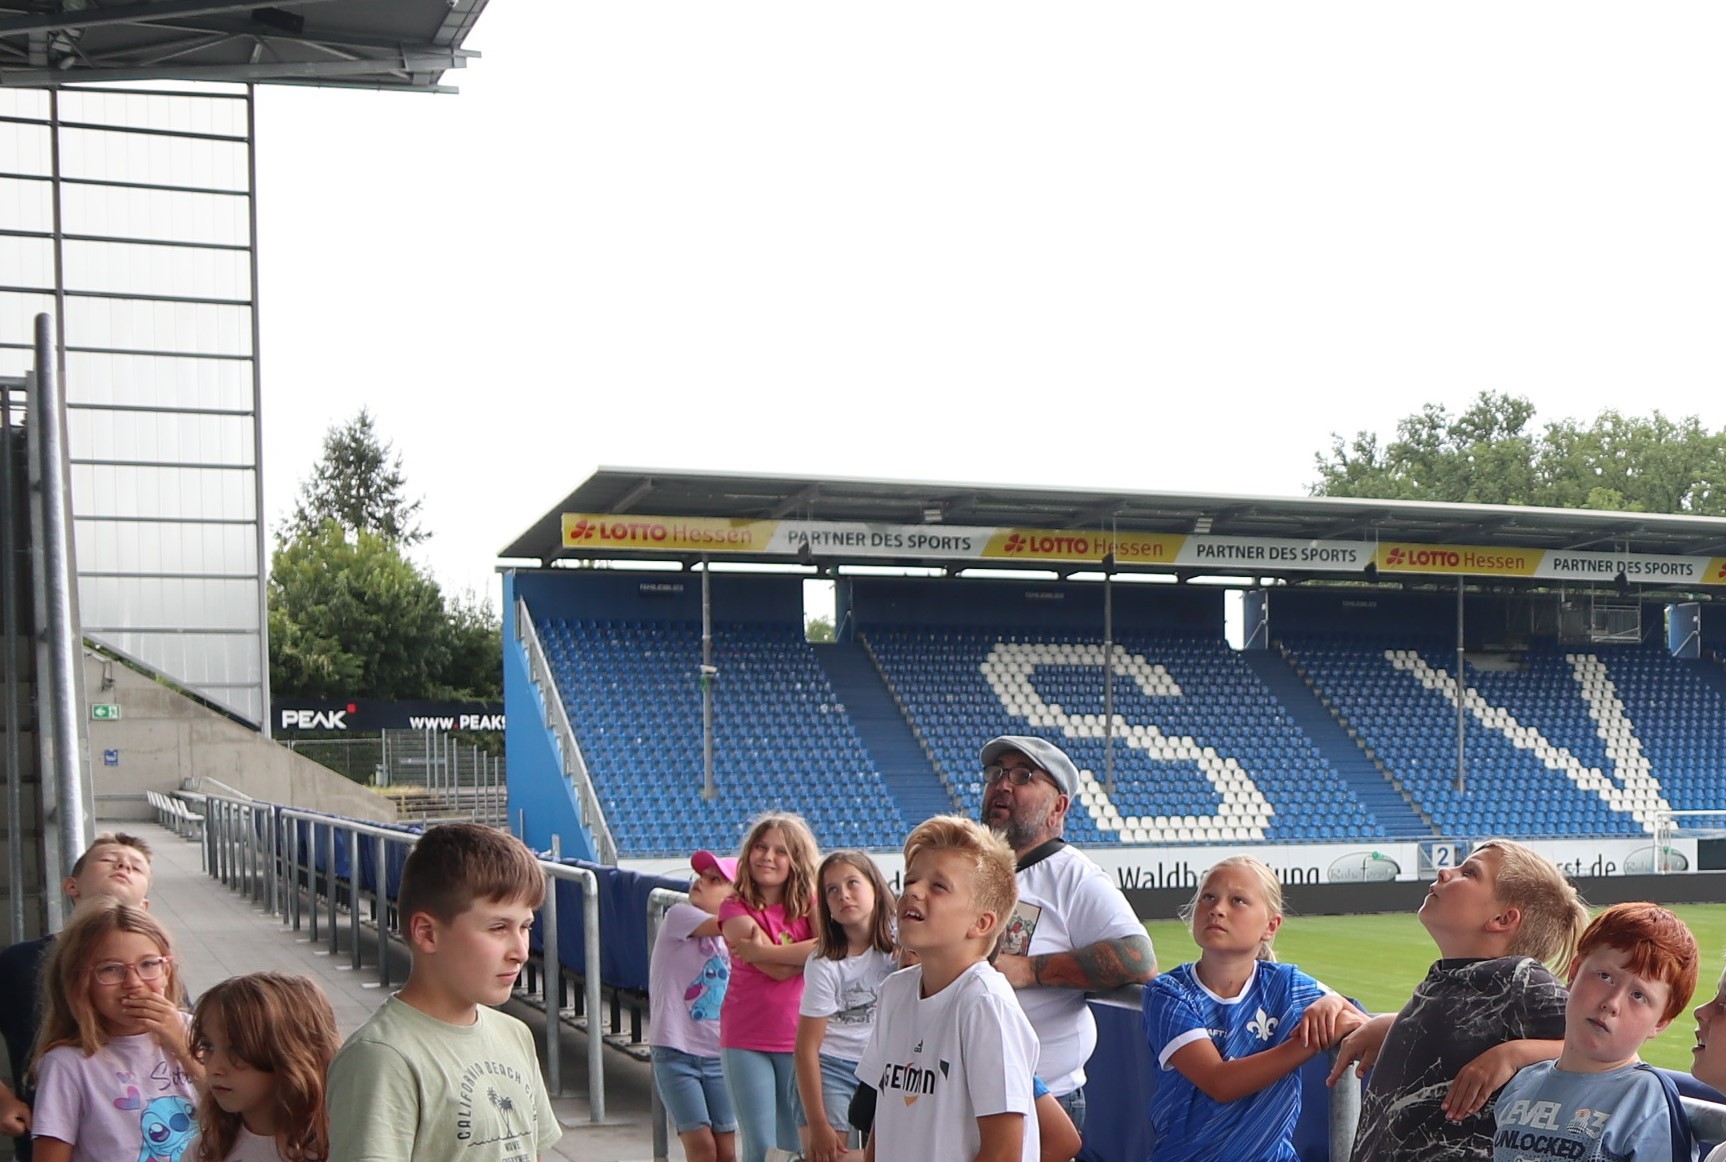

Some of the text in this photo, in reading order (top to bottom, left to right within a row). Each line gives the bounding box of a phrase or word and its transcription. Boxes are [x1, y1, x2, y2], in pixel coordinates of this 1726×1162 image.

[600, 521, 752, 544] LOTTO Hessen
[788, 530, 971, 551] PARTNER DES SPORTS
[1030, 537, 1163, 556] LOTTO Hessen
[1197, 543, 1357, 563] PARTNER DES SPORTS
[1408, 550, 1525, 570] LOTTO Hessen
[1553, 557, 1694, 576] PARTNER DES SPORTS
[282, 710, 347, 729] PEAK
[1437, 847, 1449, 865] 2
[457, 1062, 485, 1140] CALIFORNIA
[485, 1061, 521, 1084] BEACH
[1494, 1130, 1586, 1160] UNLOCKED
